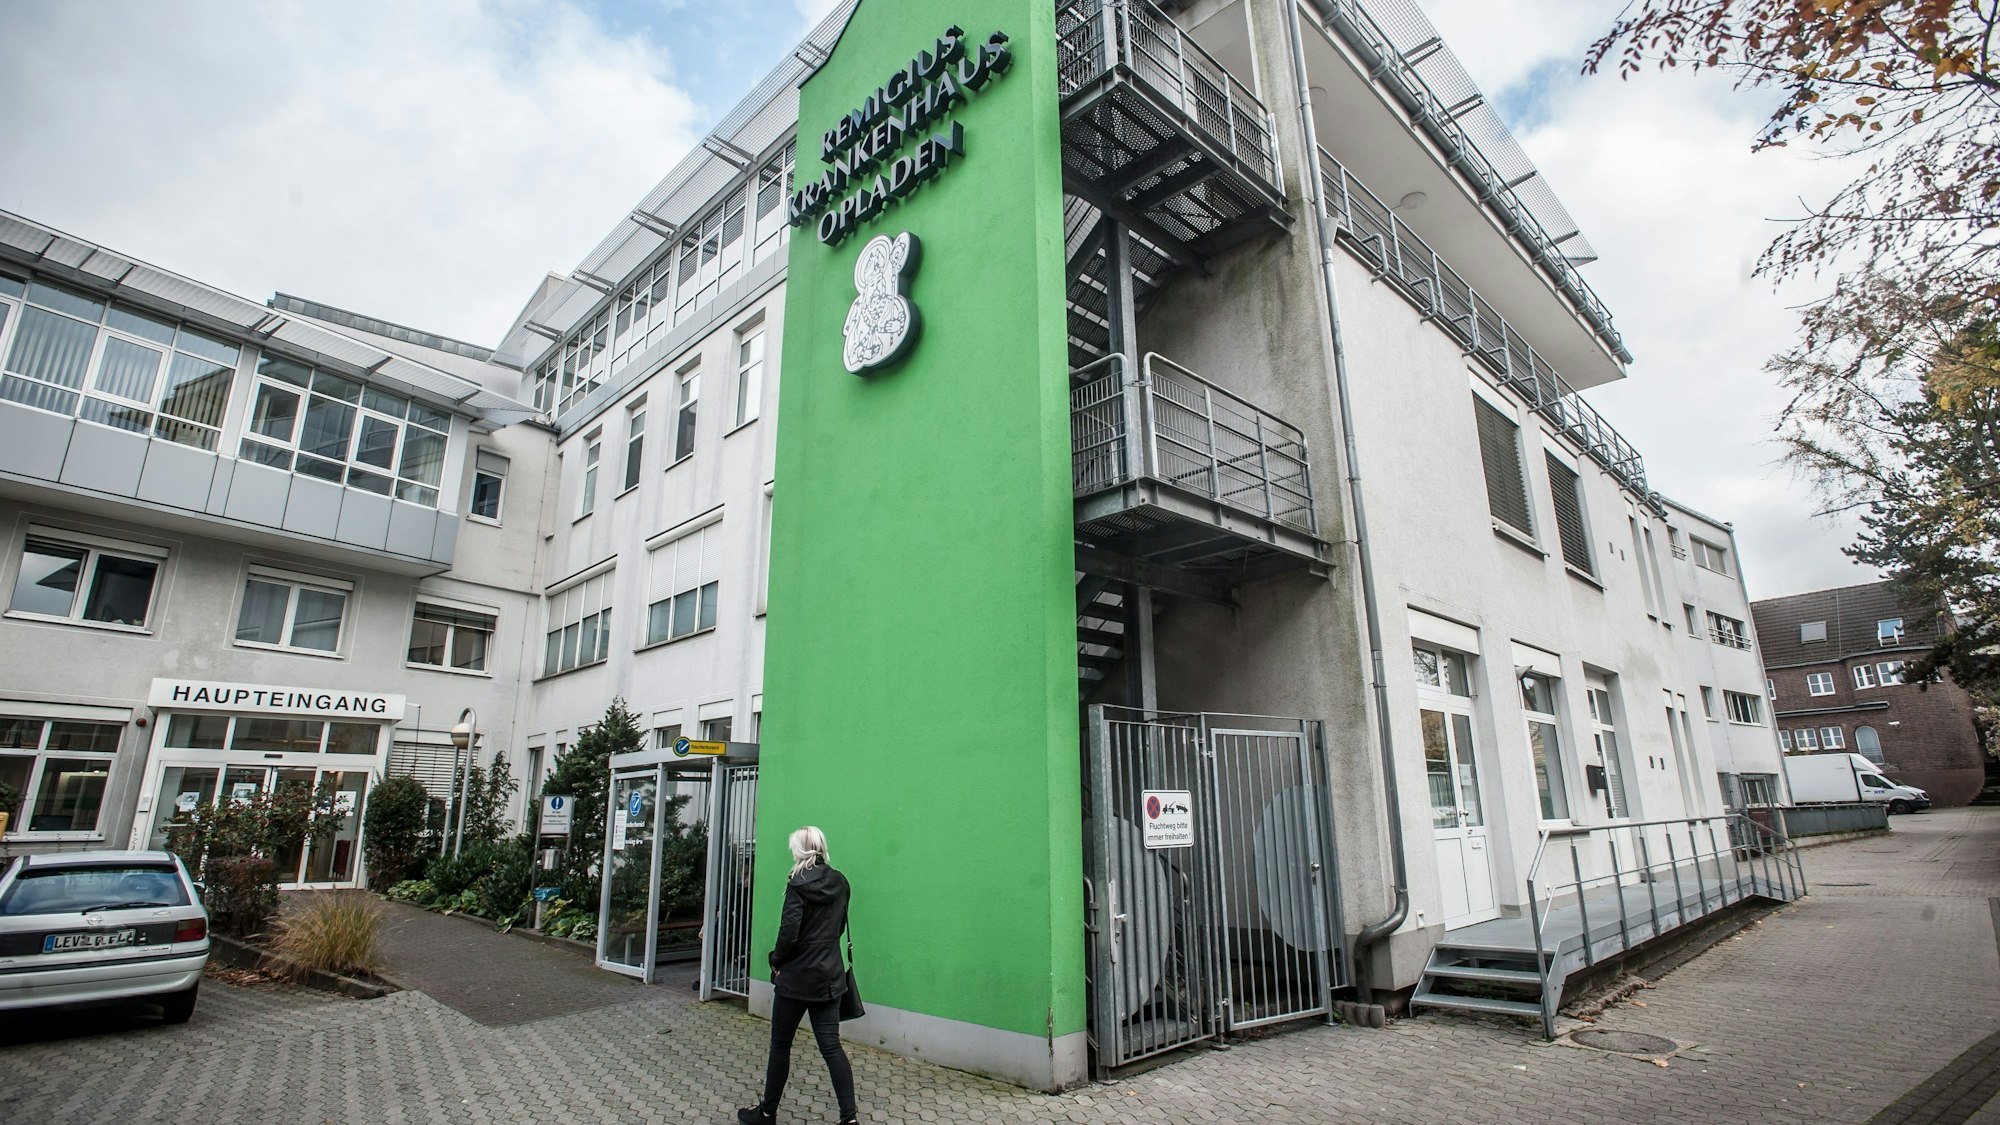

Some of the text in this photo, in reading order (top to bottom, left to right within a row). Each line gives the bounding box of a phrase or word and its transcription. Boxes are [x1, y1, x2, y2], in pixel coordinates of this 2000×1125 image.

[787, 30, 1012, 227] KRANKENHAUS
[821, 25, 965, 163] REMIGIUS
[817, 120, 965, 246] OPLADEN
[172, 685, 387, 713] HAUPTEINGANG
[1147, 833, 1164, 841] immer
[1164, 832, 1188, 841] freihalten
[1149, 822, 1176, 831] Fluchtweg
